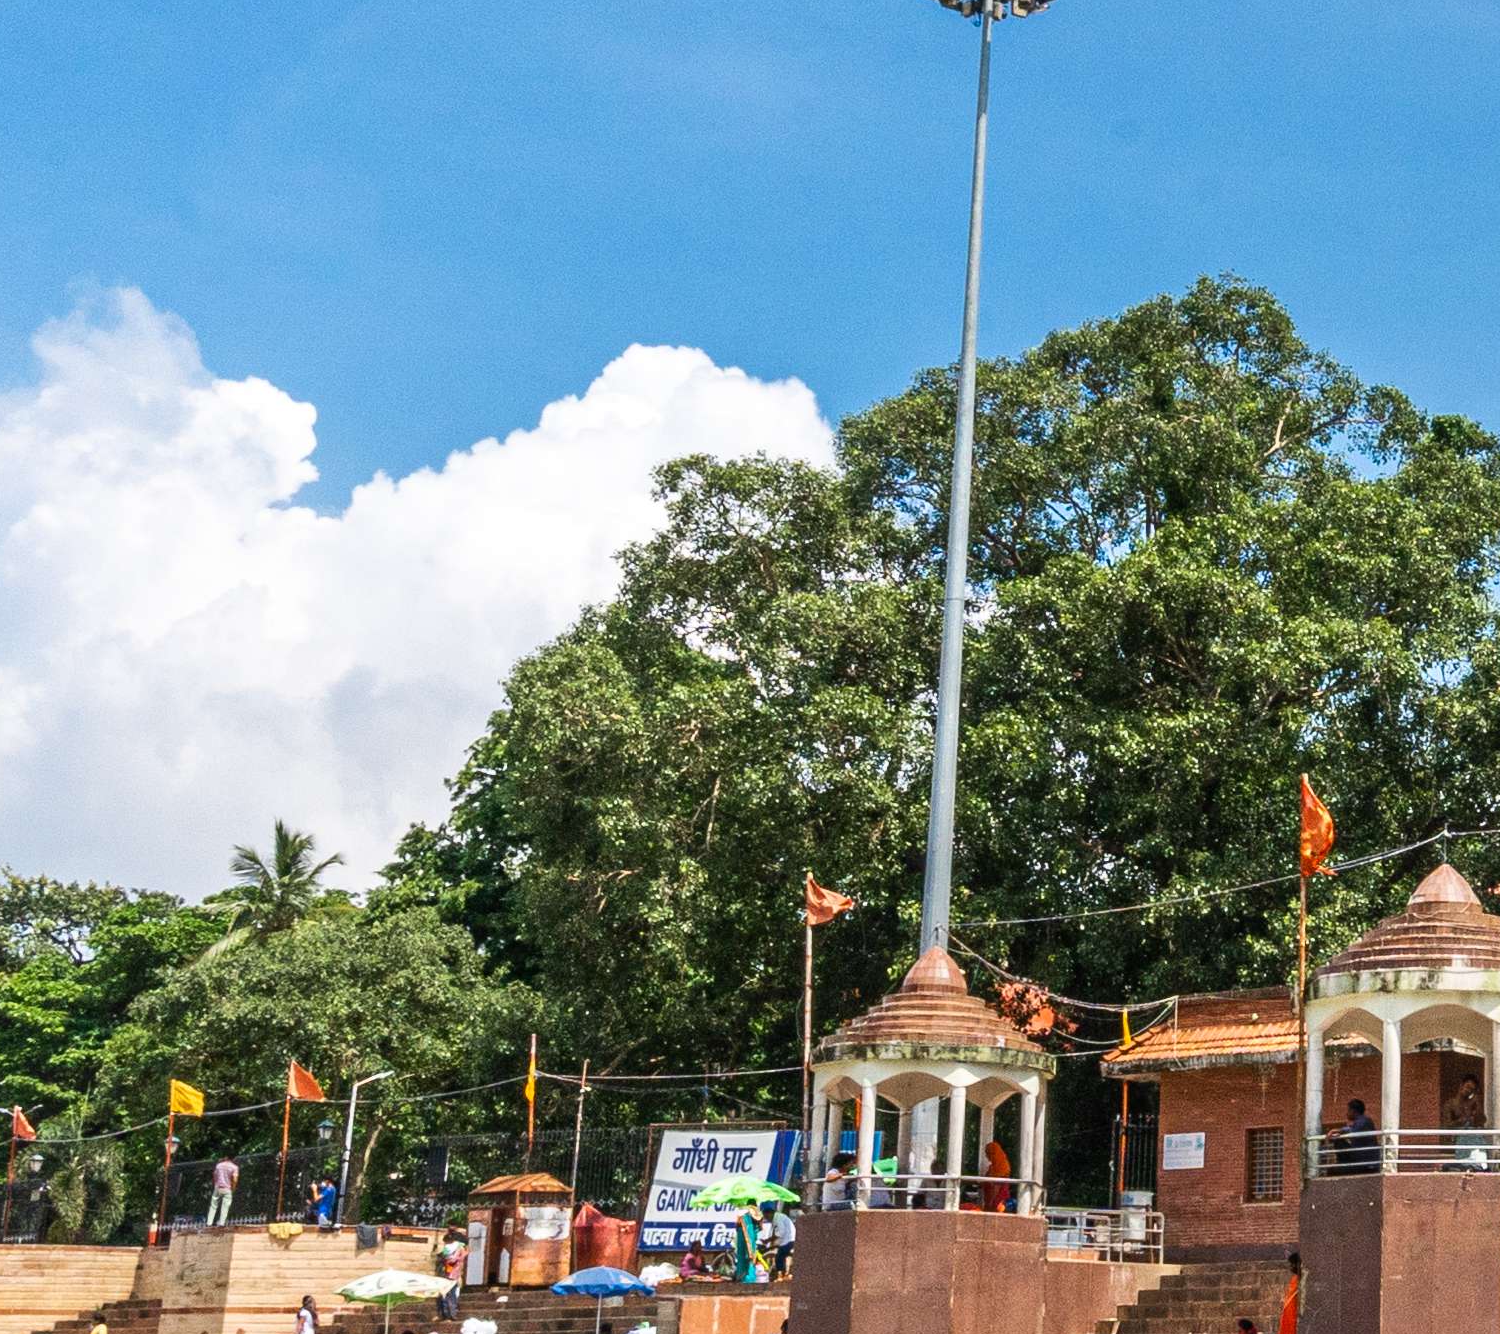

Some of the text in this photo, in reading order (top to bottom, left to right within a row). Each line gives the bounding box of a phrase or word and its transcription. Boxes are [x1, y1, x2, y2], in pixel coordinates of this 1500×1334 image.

[672, 1138, 757, 1173] गाँधी घाट
[642, 1227, 677, 1246] पटना
[680, 1228, 710, 1246] नगर
